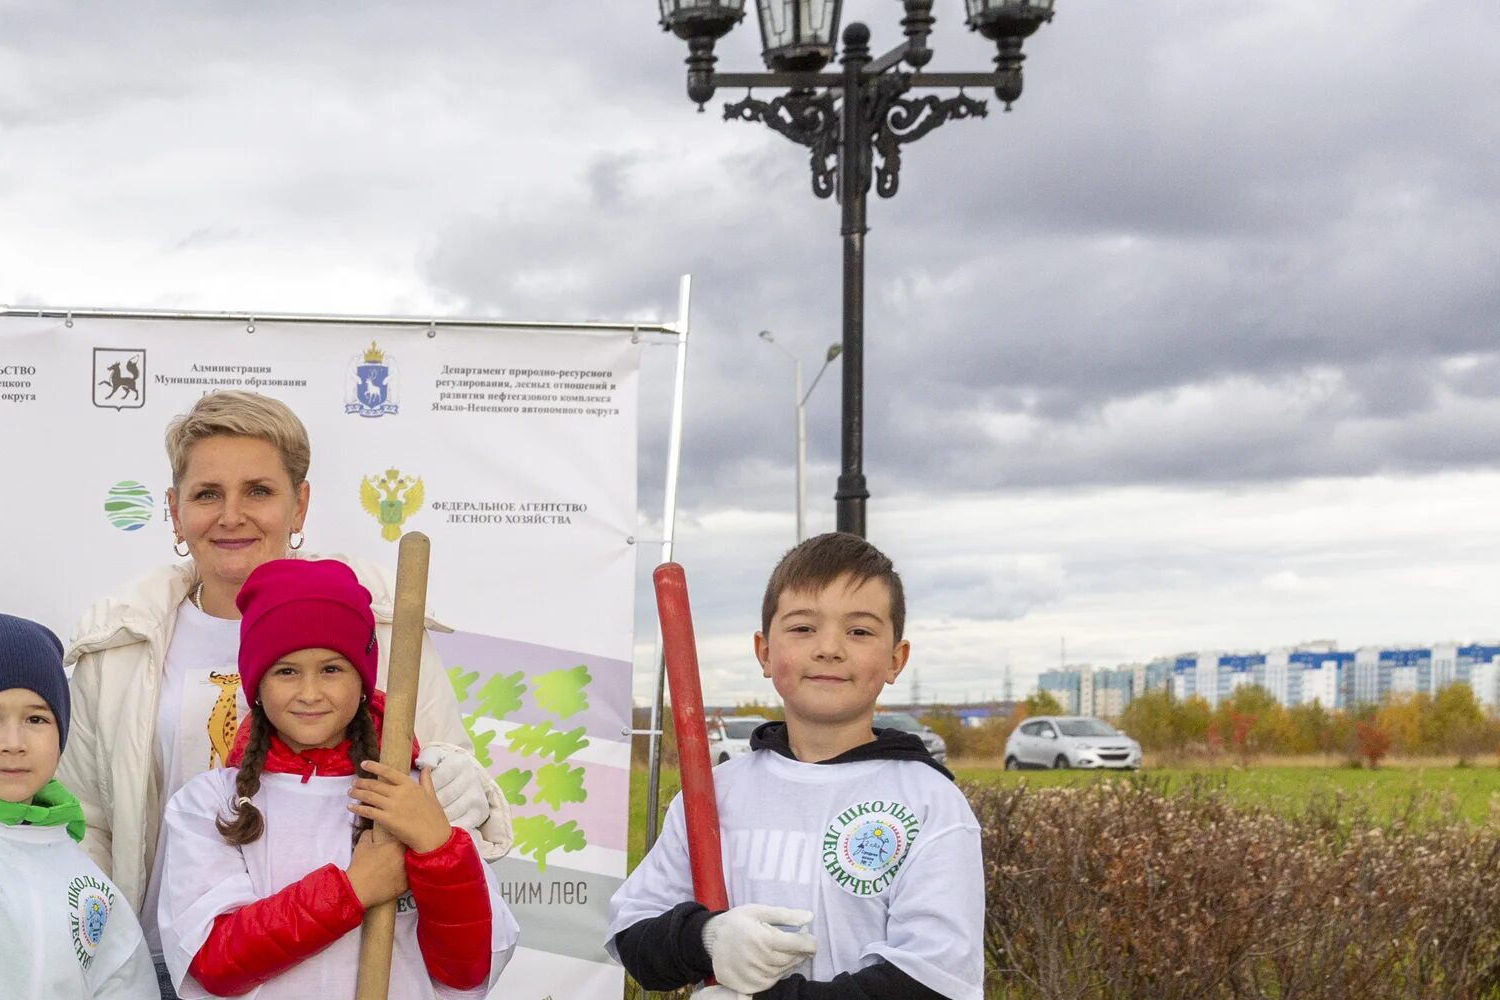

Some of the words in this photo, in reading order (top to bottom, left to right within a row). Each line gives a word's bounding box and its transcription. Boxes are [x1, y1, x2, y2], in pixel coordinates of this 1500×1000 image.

[190, 363, 272, 375] Администрация
[440, 365, 506, 377] Департамент
[508, 367, 613, 380] природно-ресурсного
[154, 374, 242, 386] Муниципального
[244, 376, 307, 388] образования
[435, 379, 513, 390] регулирования,
[514, 380, 551, 390] лесных
[553, 381, 608, 391] отношений
[609, 383, 616, 391] и
[1, 393, 37, 403] округа
[439, 391, 485, 402] развития
[487, 392, 558, 404] нефтегазового
[560, 394, 611, 404] комплекса
[430, 402, 520, 415] Ямало-Ненецкого
[521, 405, 584, 416] автономного
[585, 407, 620, 418] округа
[431, 501, 516, 512] ФЕДЕРАЛЬНОЕ
[518, 502, 588, 513] АГЕНТСТВО
[446, 514, 503, 525] ЛЕСНОГО
[504, 513, 572, 525] ХОЗЯЙСТВА
[68, 875, 116, 911] ШКОЛЬНО
